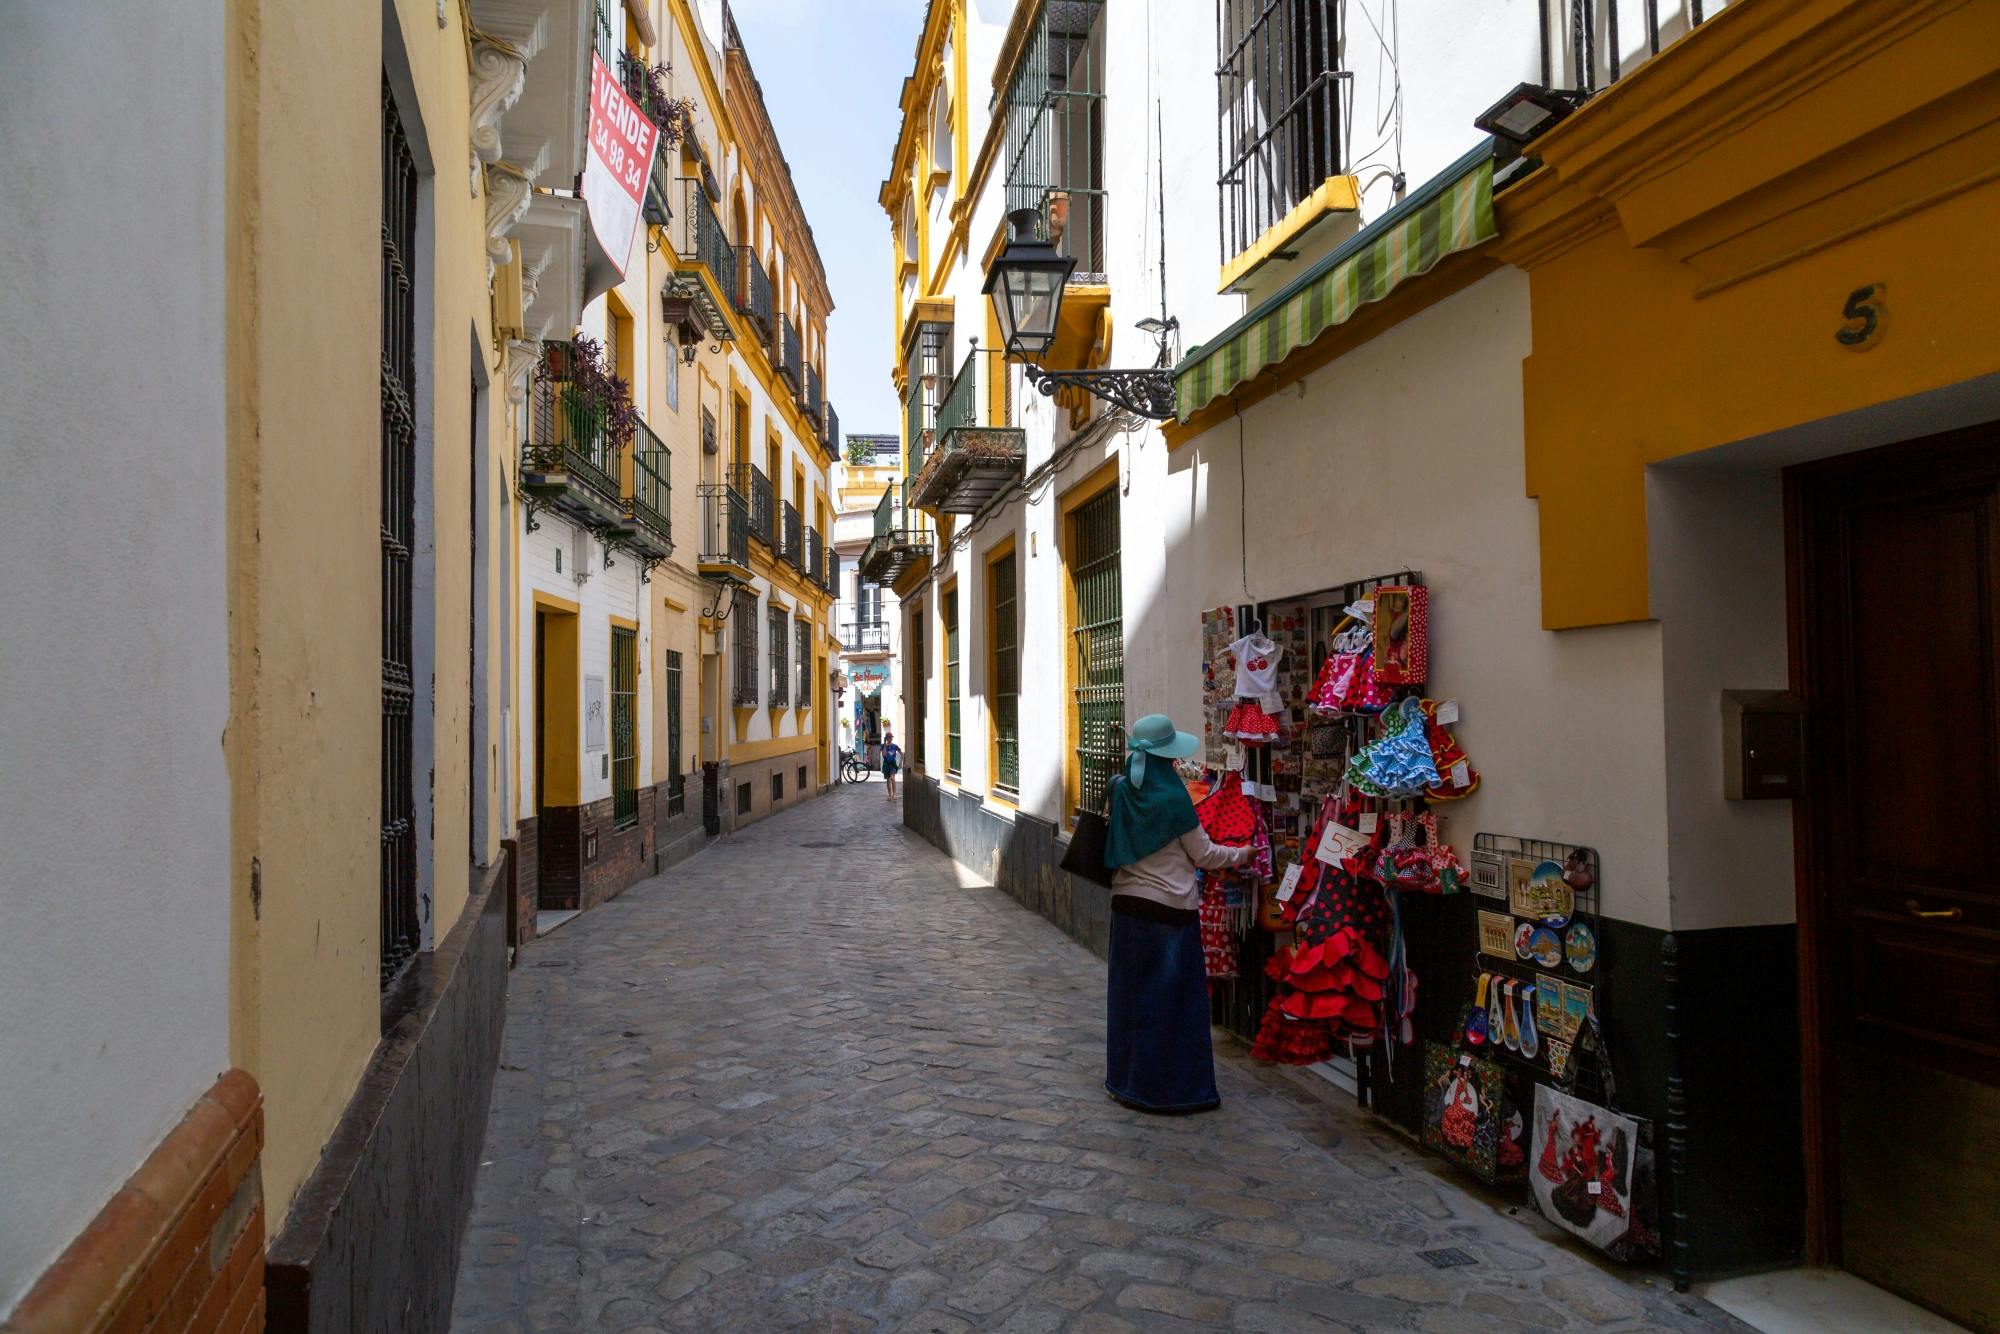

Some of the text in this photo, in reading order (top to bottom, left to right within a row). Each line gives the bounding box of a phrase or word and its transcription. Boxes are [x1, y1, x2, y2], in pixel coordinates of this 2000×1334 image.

[600, 72, 651, 158] VENDE
[595, 118, 609, 154] 34
[609, 138, 624, 173] 98
[625, 158, 641, 192] 34
[1835, 285, 1878, 346] 5
